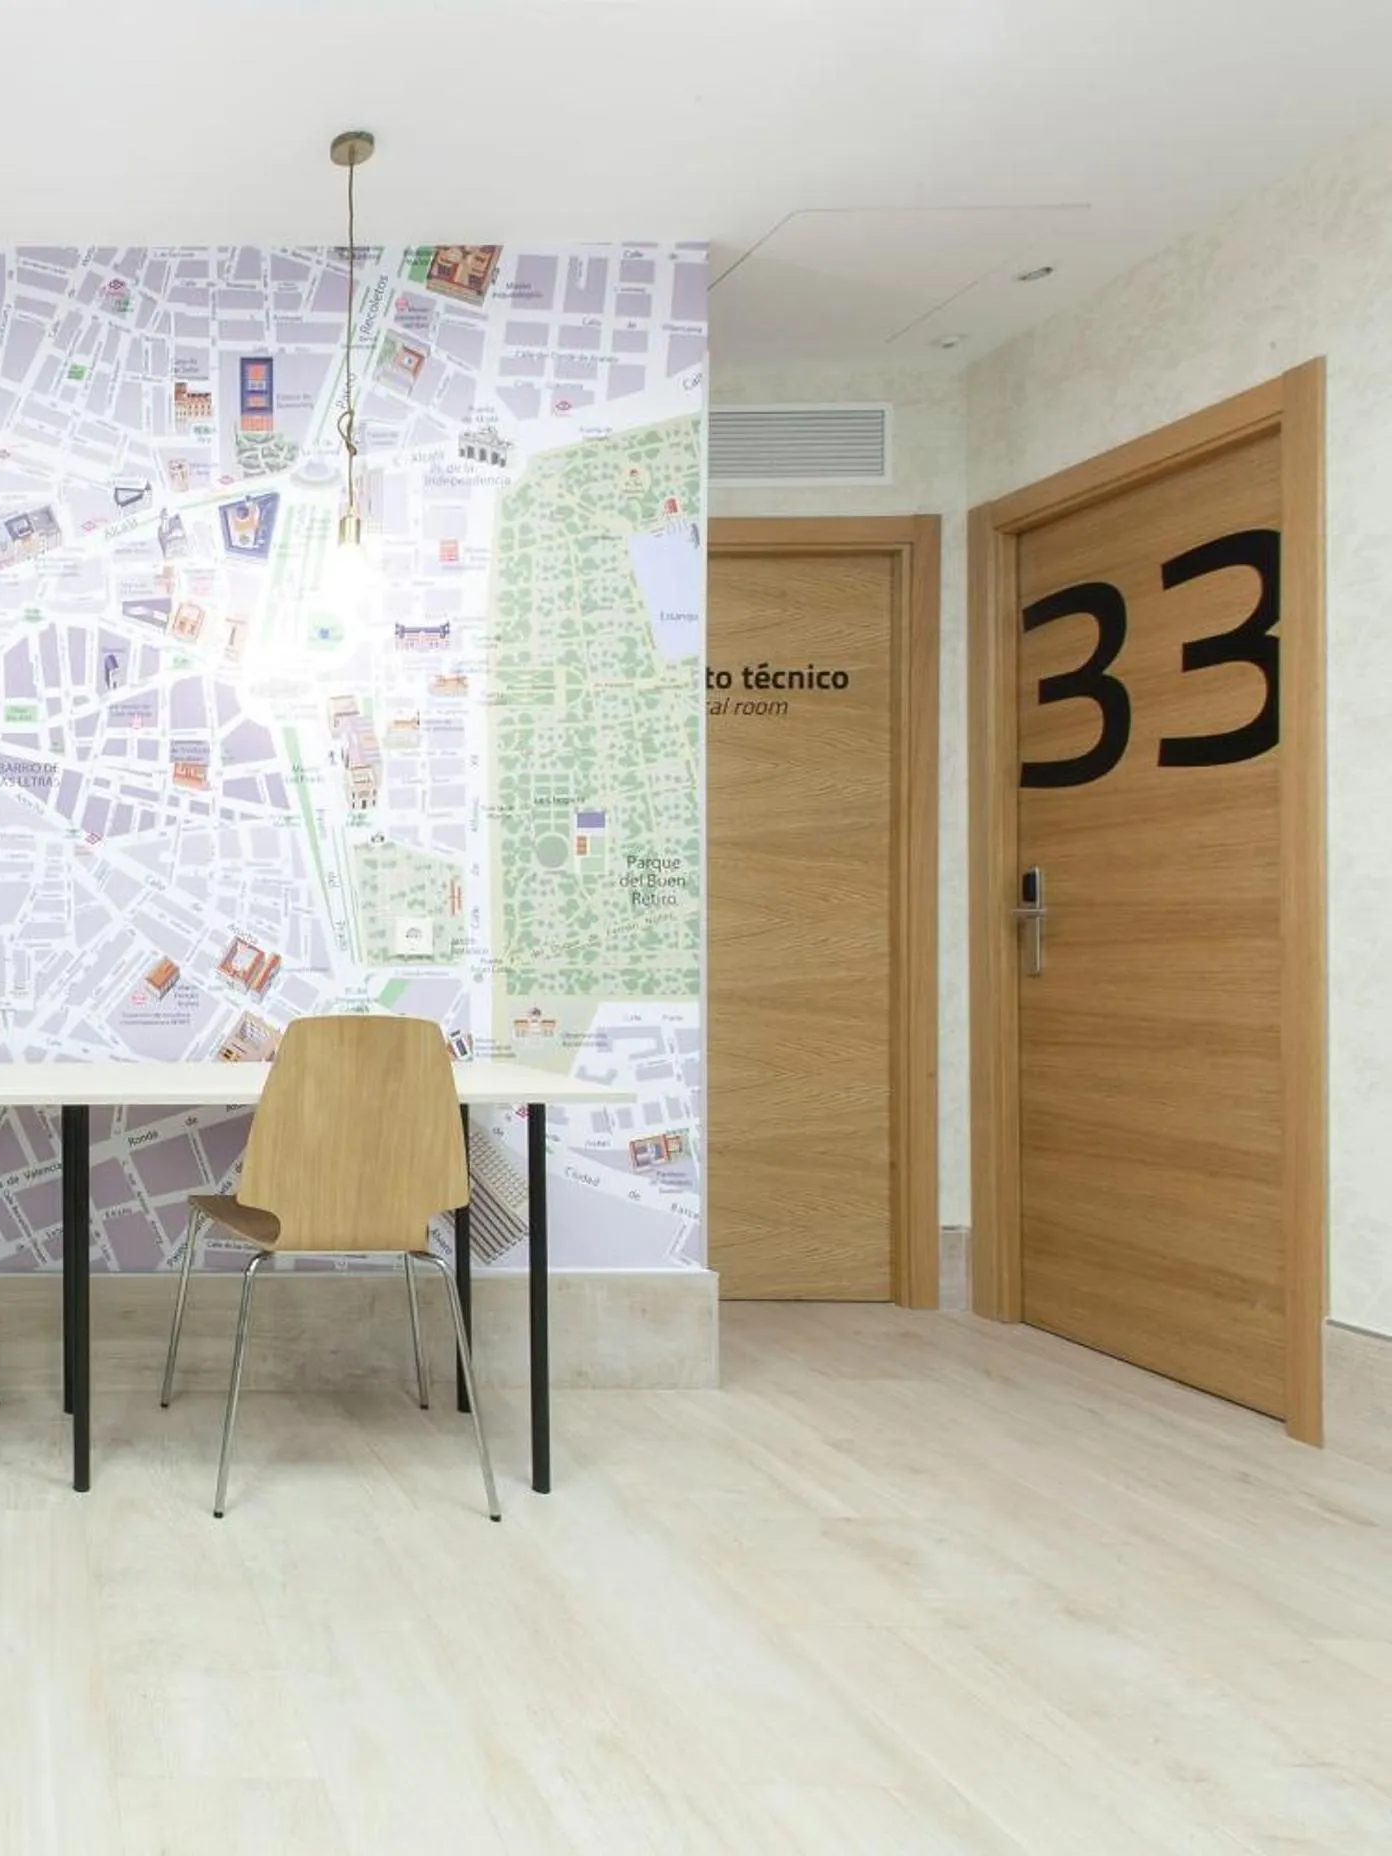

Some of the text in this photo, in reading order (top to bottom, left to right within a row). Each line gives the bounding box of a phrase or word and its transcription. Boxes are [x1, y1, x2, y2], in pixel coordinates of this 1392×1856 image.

[1020, 528, 1281, 789] 33
[742, 662, 850, 690] técnico
[734, 699, 789, 715] room
[626, 855, 681, 872] Parque
[619, 873, 687, 889] del Buen
[631, 891, 677, 907] Retiro
[127, 1129, 159, 1147] Ronda
[23, 1161, 63, 1181] Valencia
